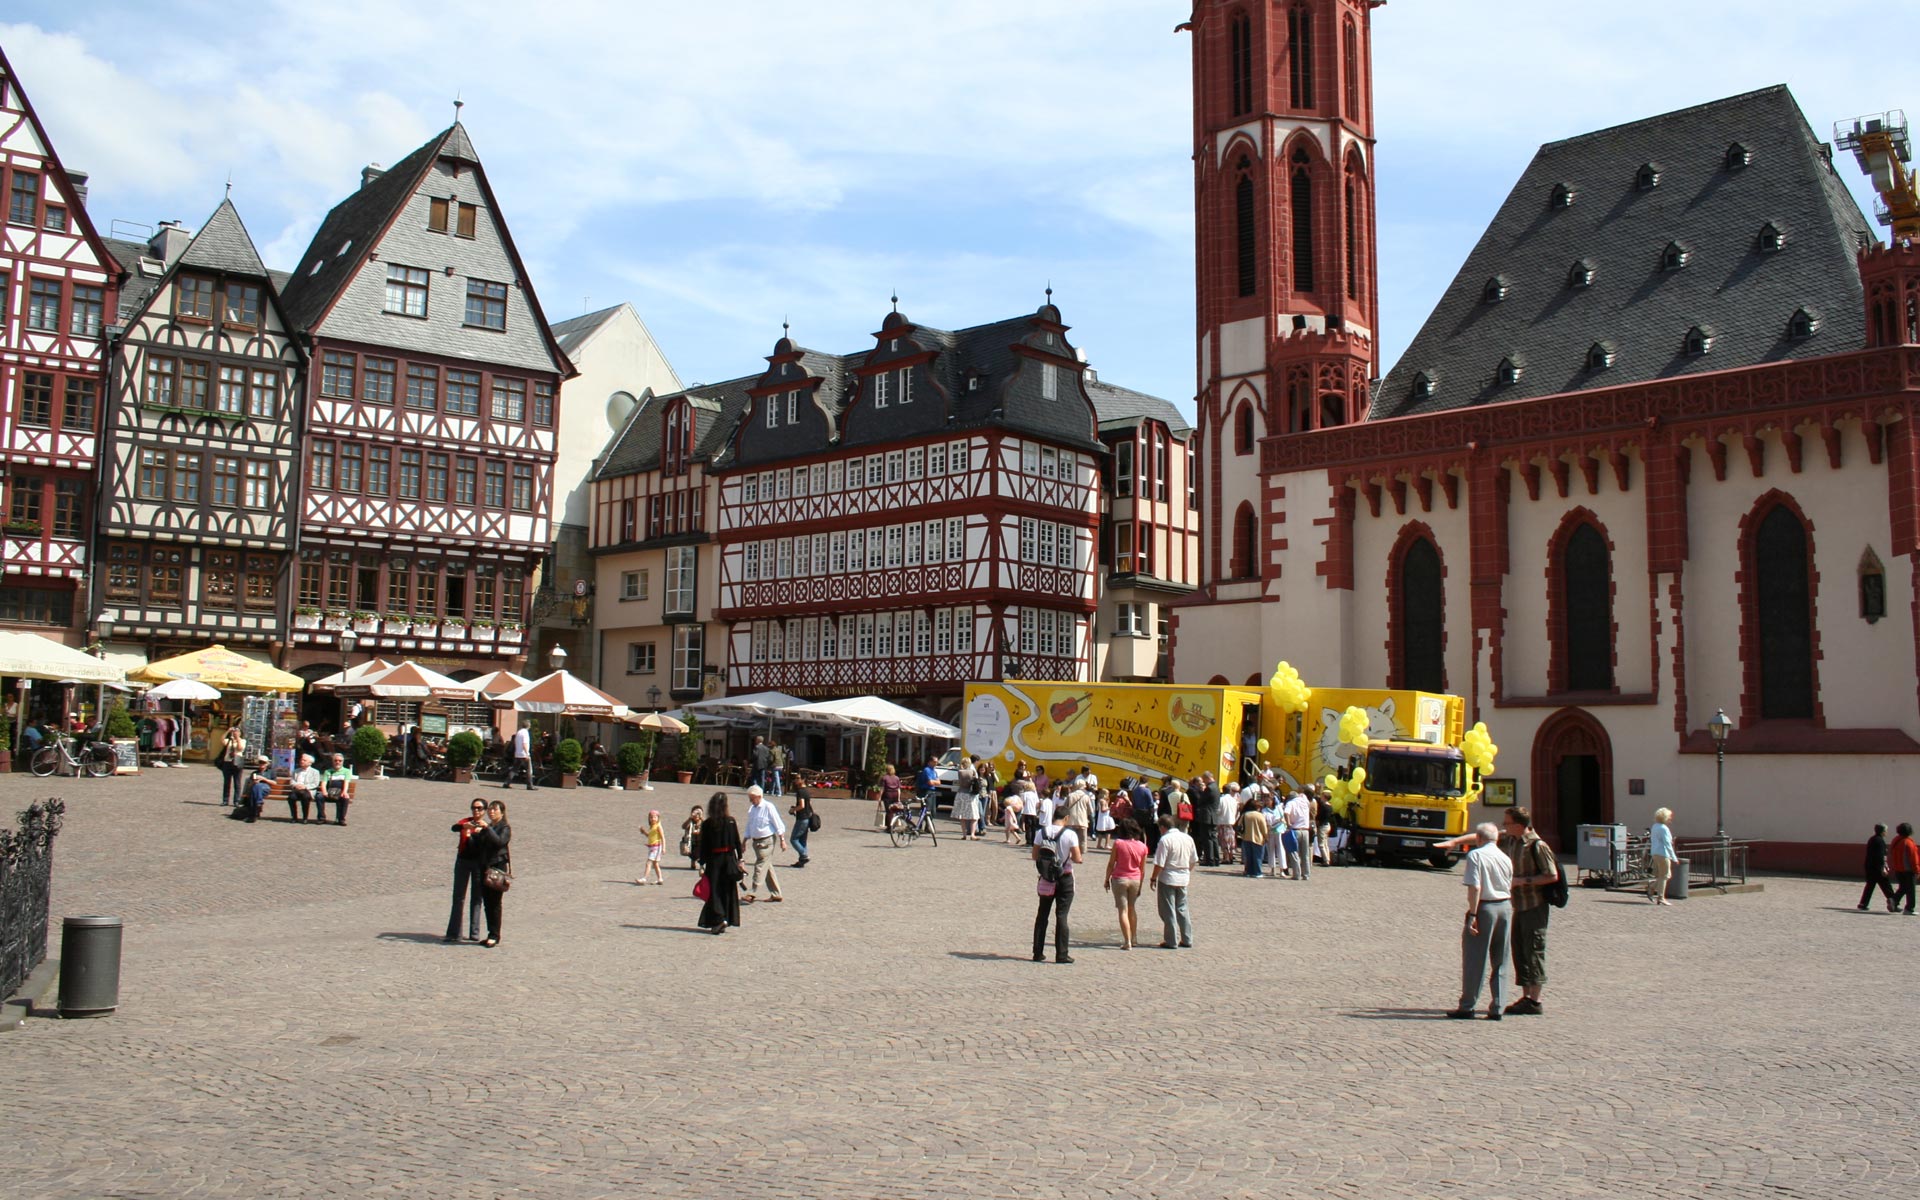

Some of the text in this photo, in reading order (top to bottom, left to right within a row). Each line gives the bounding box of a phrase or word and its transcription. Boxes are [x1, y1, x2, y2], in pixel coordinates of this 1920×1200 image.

[778, 686, 828, 697] RESTAURANT
[887, 684, 917, 694] STERN
[1092, 716, 1181, 749] MUSIKMOBIL
[1097, 731, 1184, 765] FRANKFURT
[1400, 813, 1429, 821] MAN
